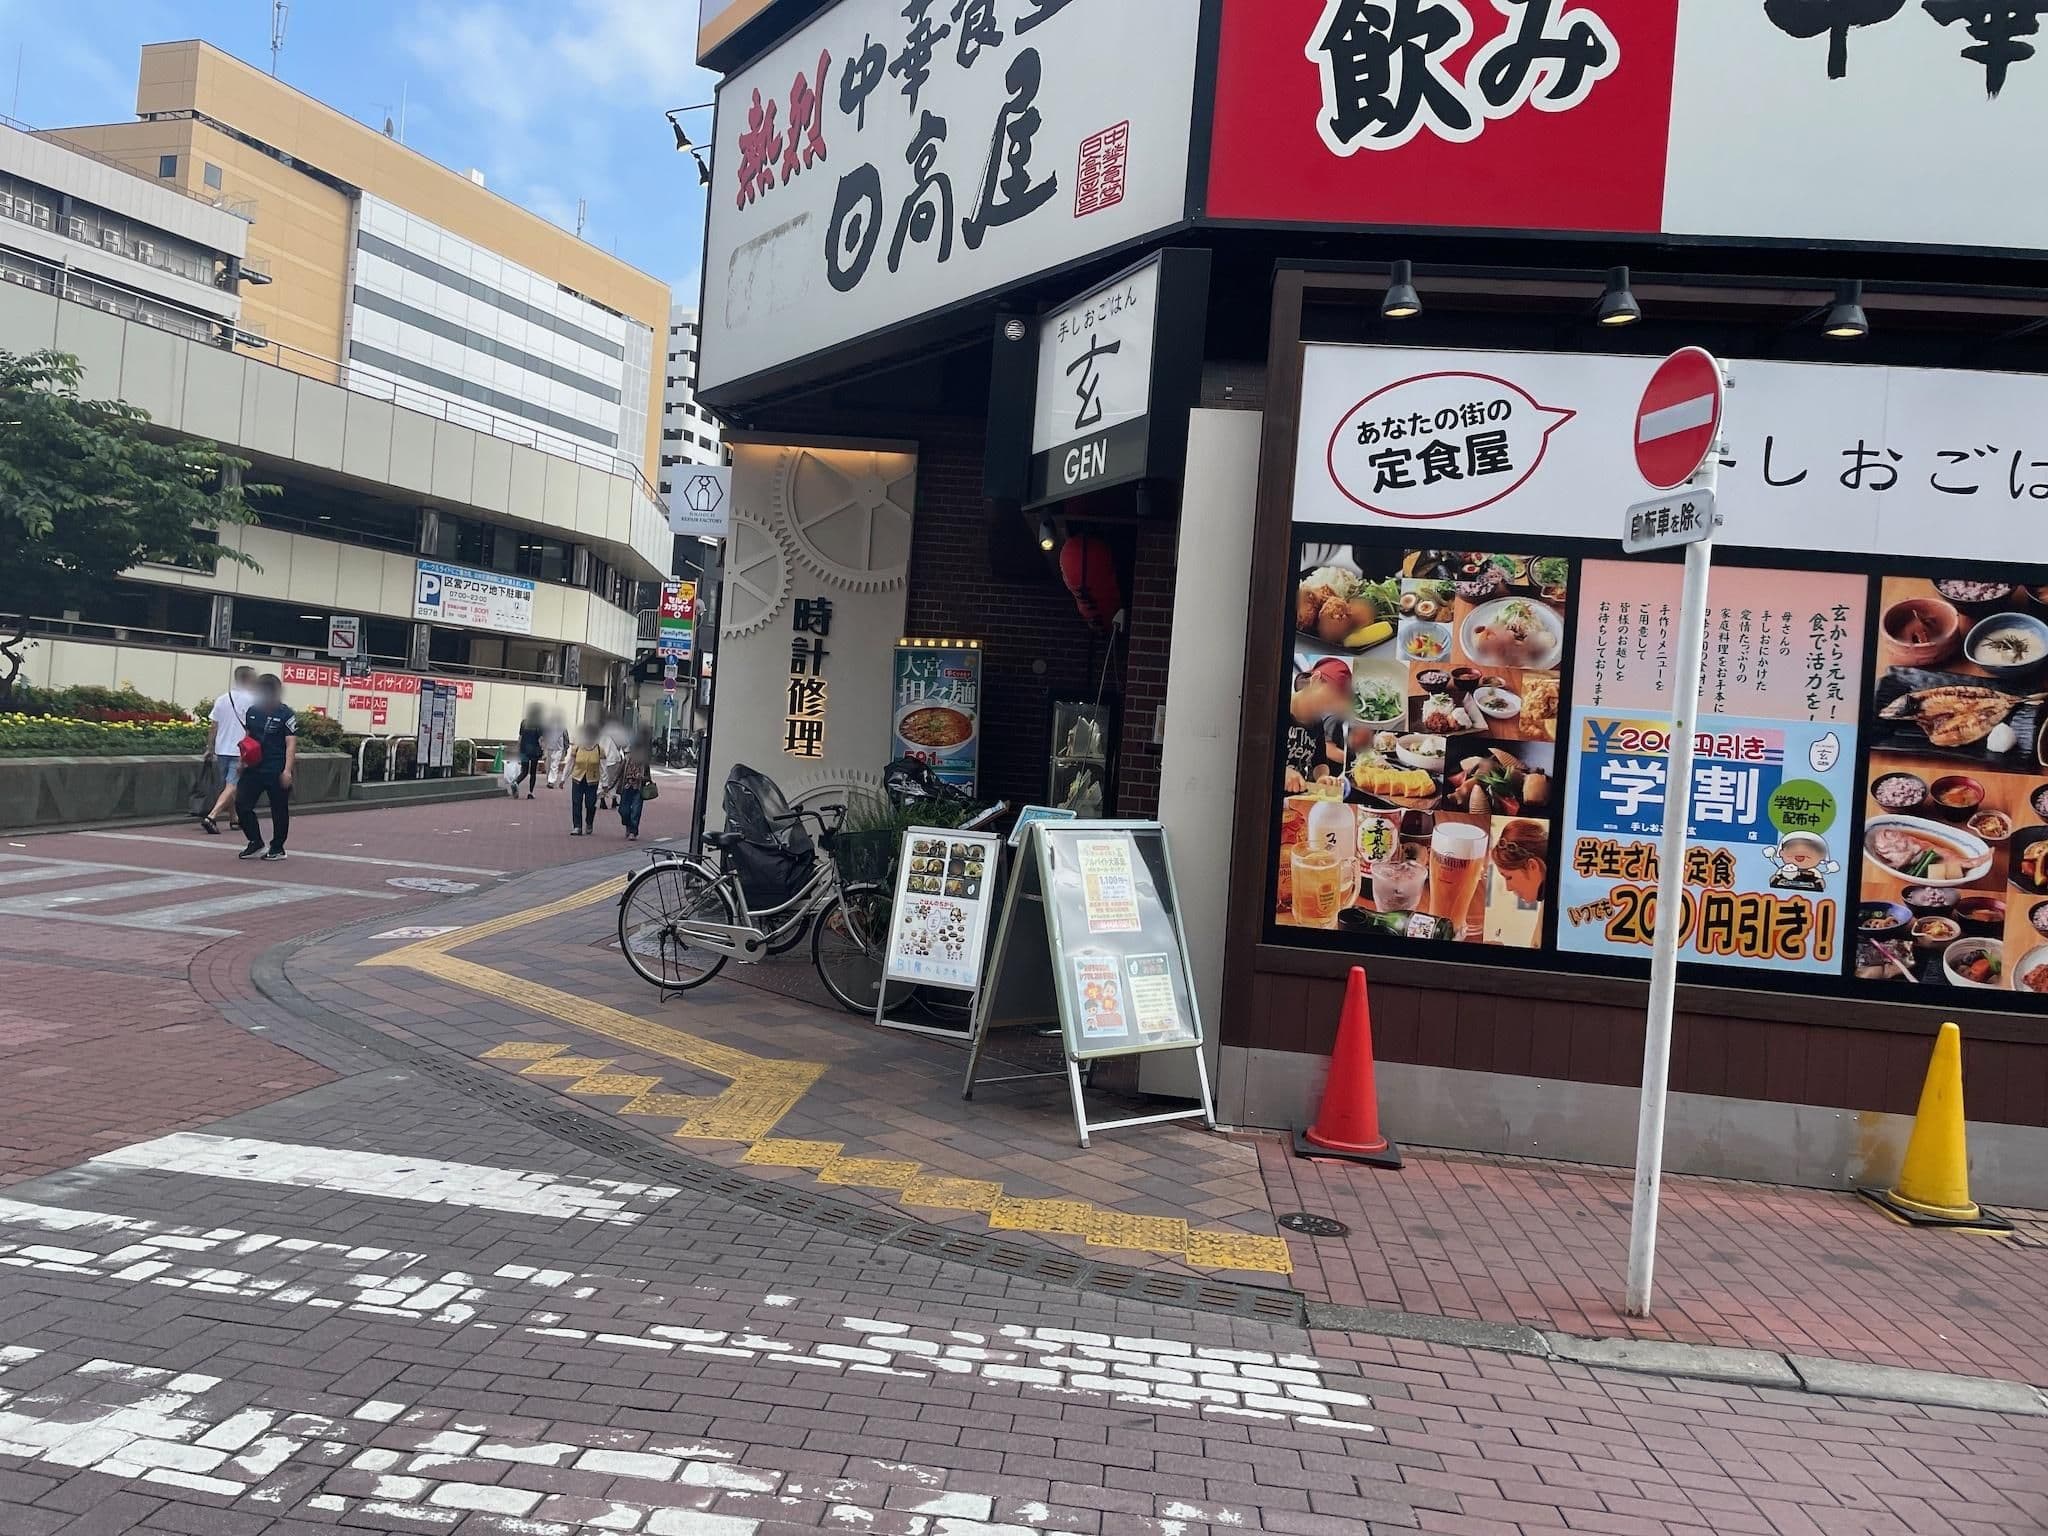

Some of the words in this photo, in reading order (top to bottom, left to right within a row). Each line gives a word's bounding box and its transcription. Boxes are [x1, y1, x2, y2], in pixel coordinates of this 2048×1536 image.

[737, 49, 832, 210] 熱烈
[838, 0, 1074, 131] 中華食
[1305, 0, 1619, 155] 飲み
[825, 47, 1058, 292] 日高屋
[1056, 286, 1138, 344] 手しおごはん
[1066, 333, 1122, 430] 玄
[1356, 399, 1513, 445] あなたの街の
[1063, 438, 1108, 486] GEN
[1368, 429, 1514, 494] 定食屋
[1718, 435, 2048, 500] しおごは
[1630, 502, 1704, 542] 自転車を除く
[419, 572, 441, 604] P
[444, 576, 531, 602] 区営アロマ地下駐車場
[664, 602, 692, 613] カラオケ
[660, 628, 692, 639] FamilyMart
[1592, 601, 1611, 706] お待ちしております
[1615, 602, 1631, 681] 皆様のお越しを
[1637, 603, 1651, 660] ご用意して
[1655, 604, 1671, 691] 手作りメニューを
[1714, 607, 1731, 713] 家庭料理をお手本に
[1736, 608, 1752, 684] 愛情たっぷりの
[1756, 610, 1772, 691] 手しおにかけた
[1779, 611, 1793, 656] 母さんの
[783, 597, 833, 758] 時計修理
[902, 655, 943, 678] 大宮
[1826, 604, 1850, 719] 玄から元気!
[898, 678, 977, 708] 担々麺
[1600, 759, 1760, 825] 学割
[1774, 794, 1833, 812] 学割カード
[1782, 811, 1821, 827] 配布中
[1574, 840, 1733, 888] 学生さん定食
[1567, 900, 1615, 925] いつでも
